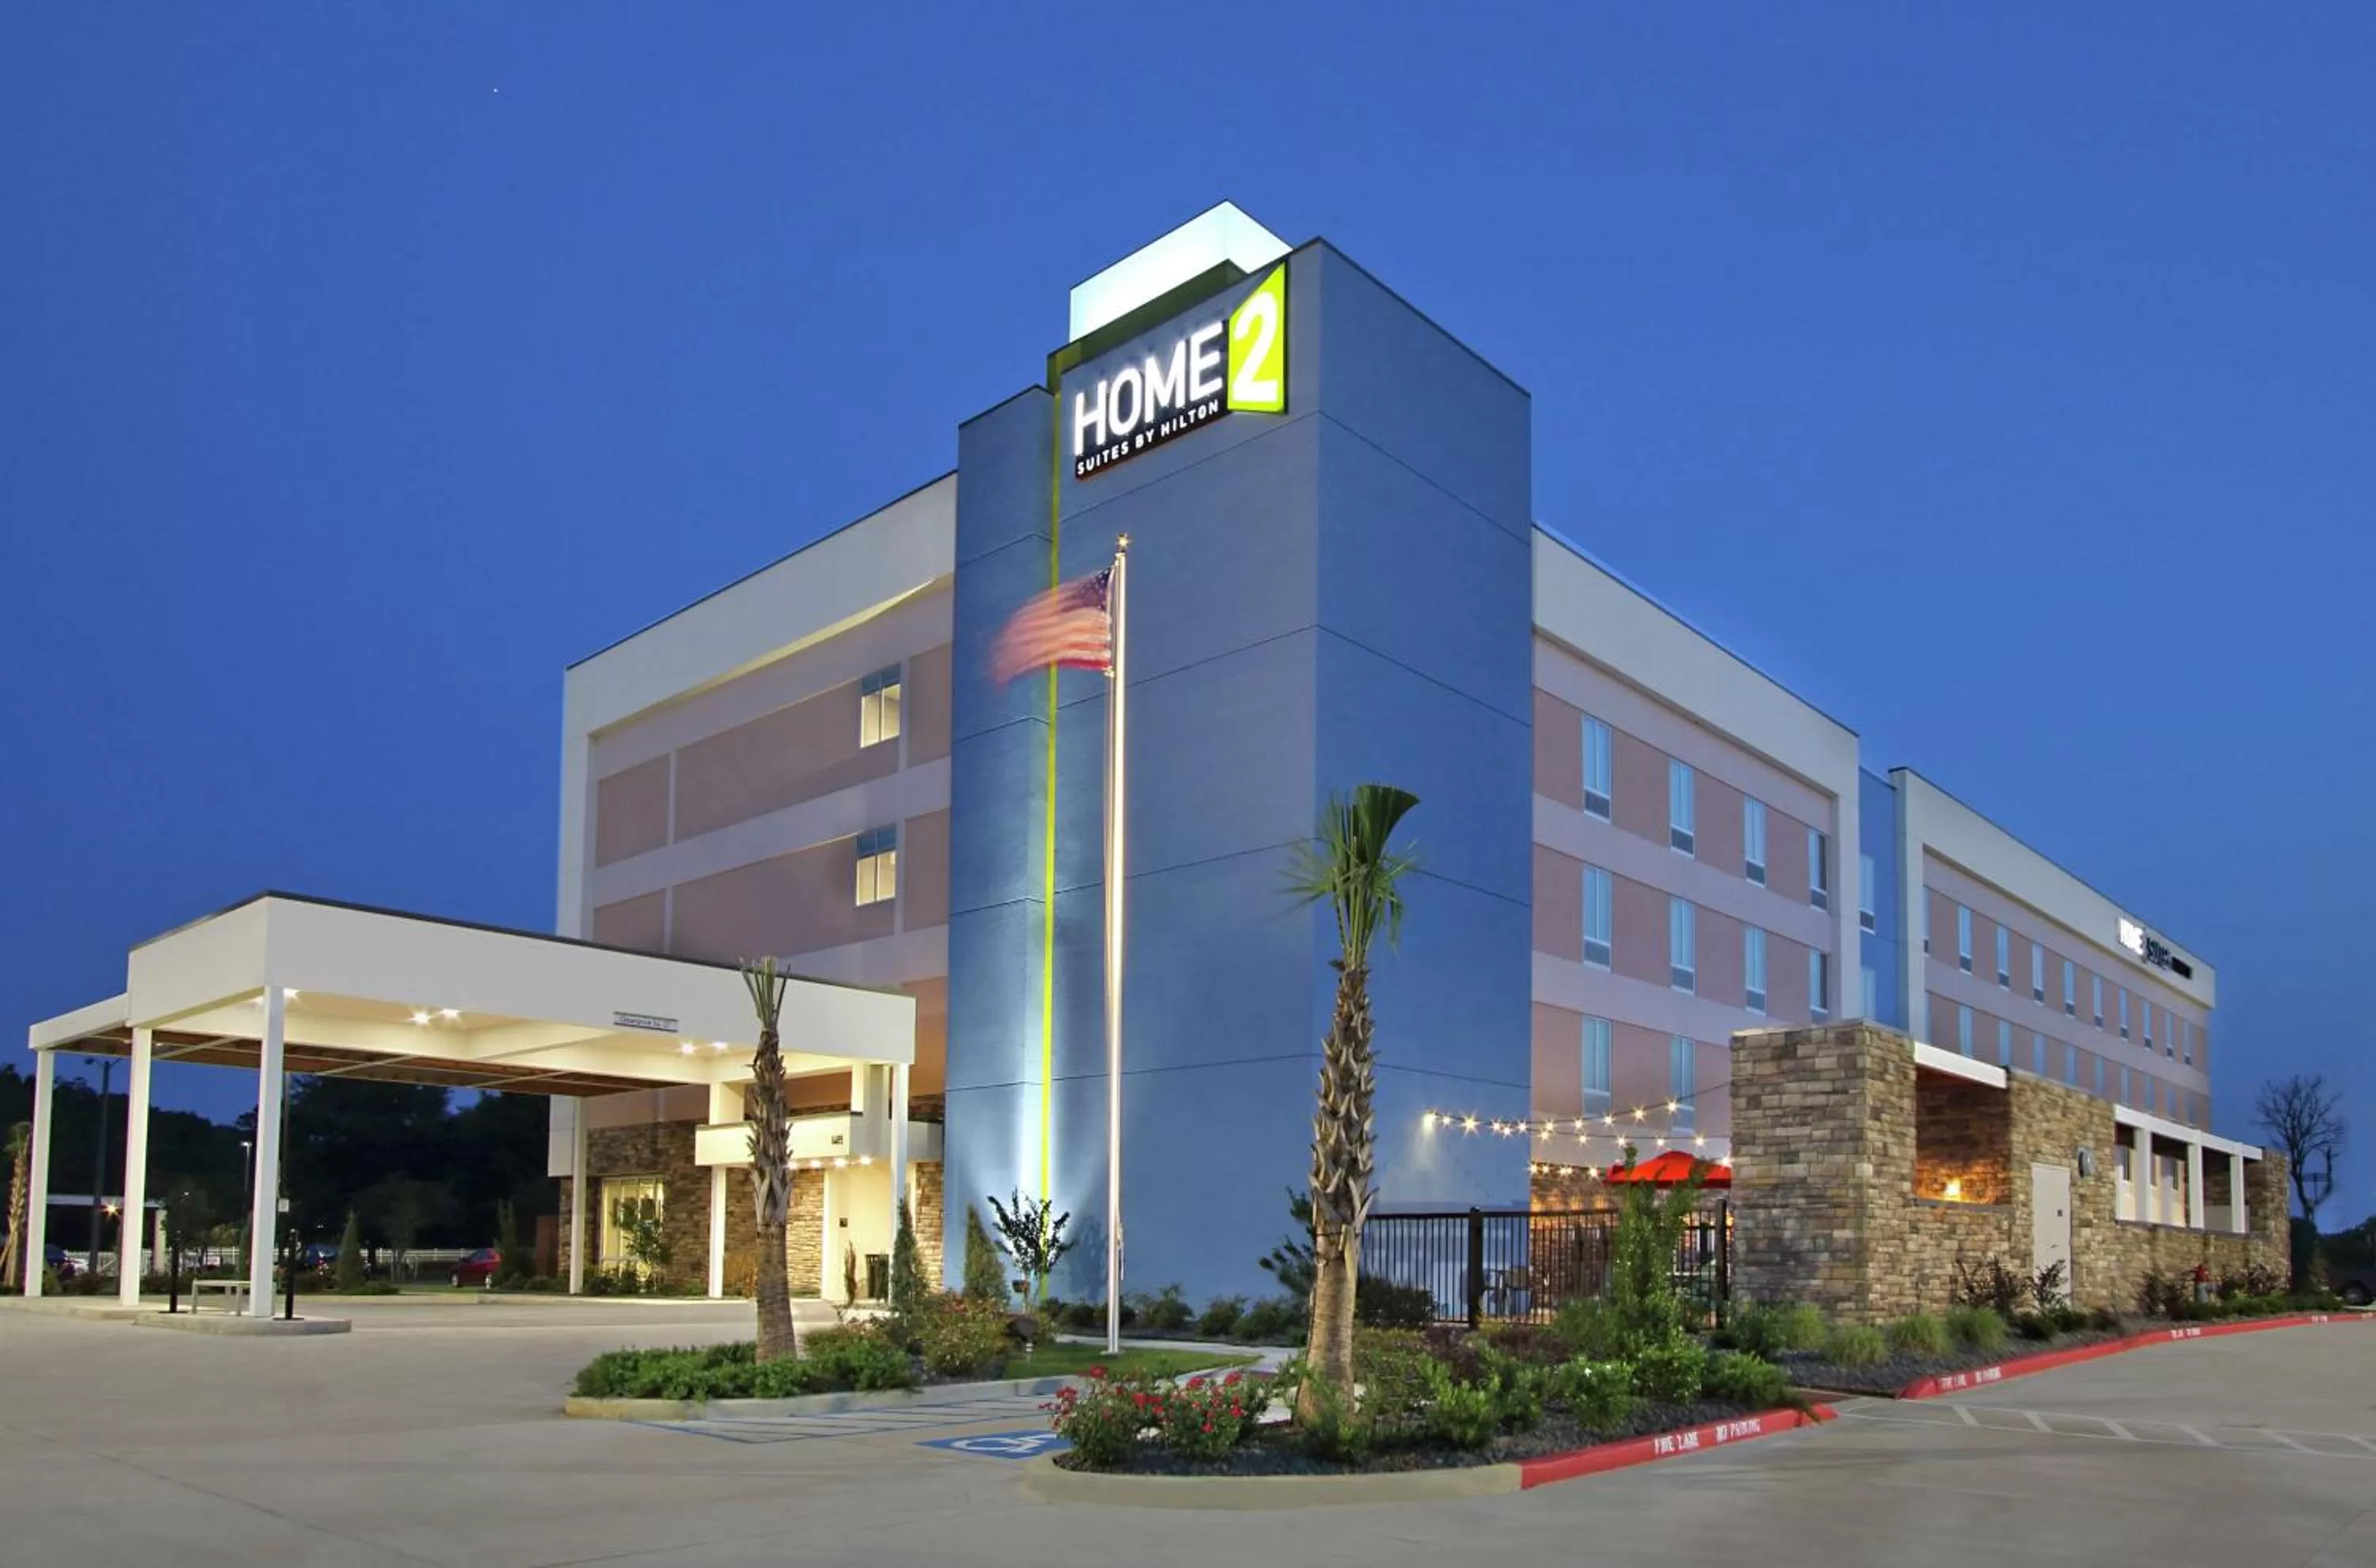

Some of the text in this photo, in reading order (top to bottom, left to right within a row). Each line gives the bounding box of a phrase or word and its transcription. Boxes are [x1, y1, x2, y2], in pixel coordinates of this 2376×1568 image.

[1077, 399, 1219, 475] SUITES BY HILTON
[1676, 1431, 1700, 1451] LANE
[1715, 1425, 1727, 1442] NO
